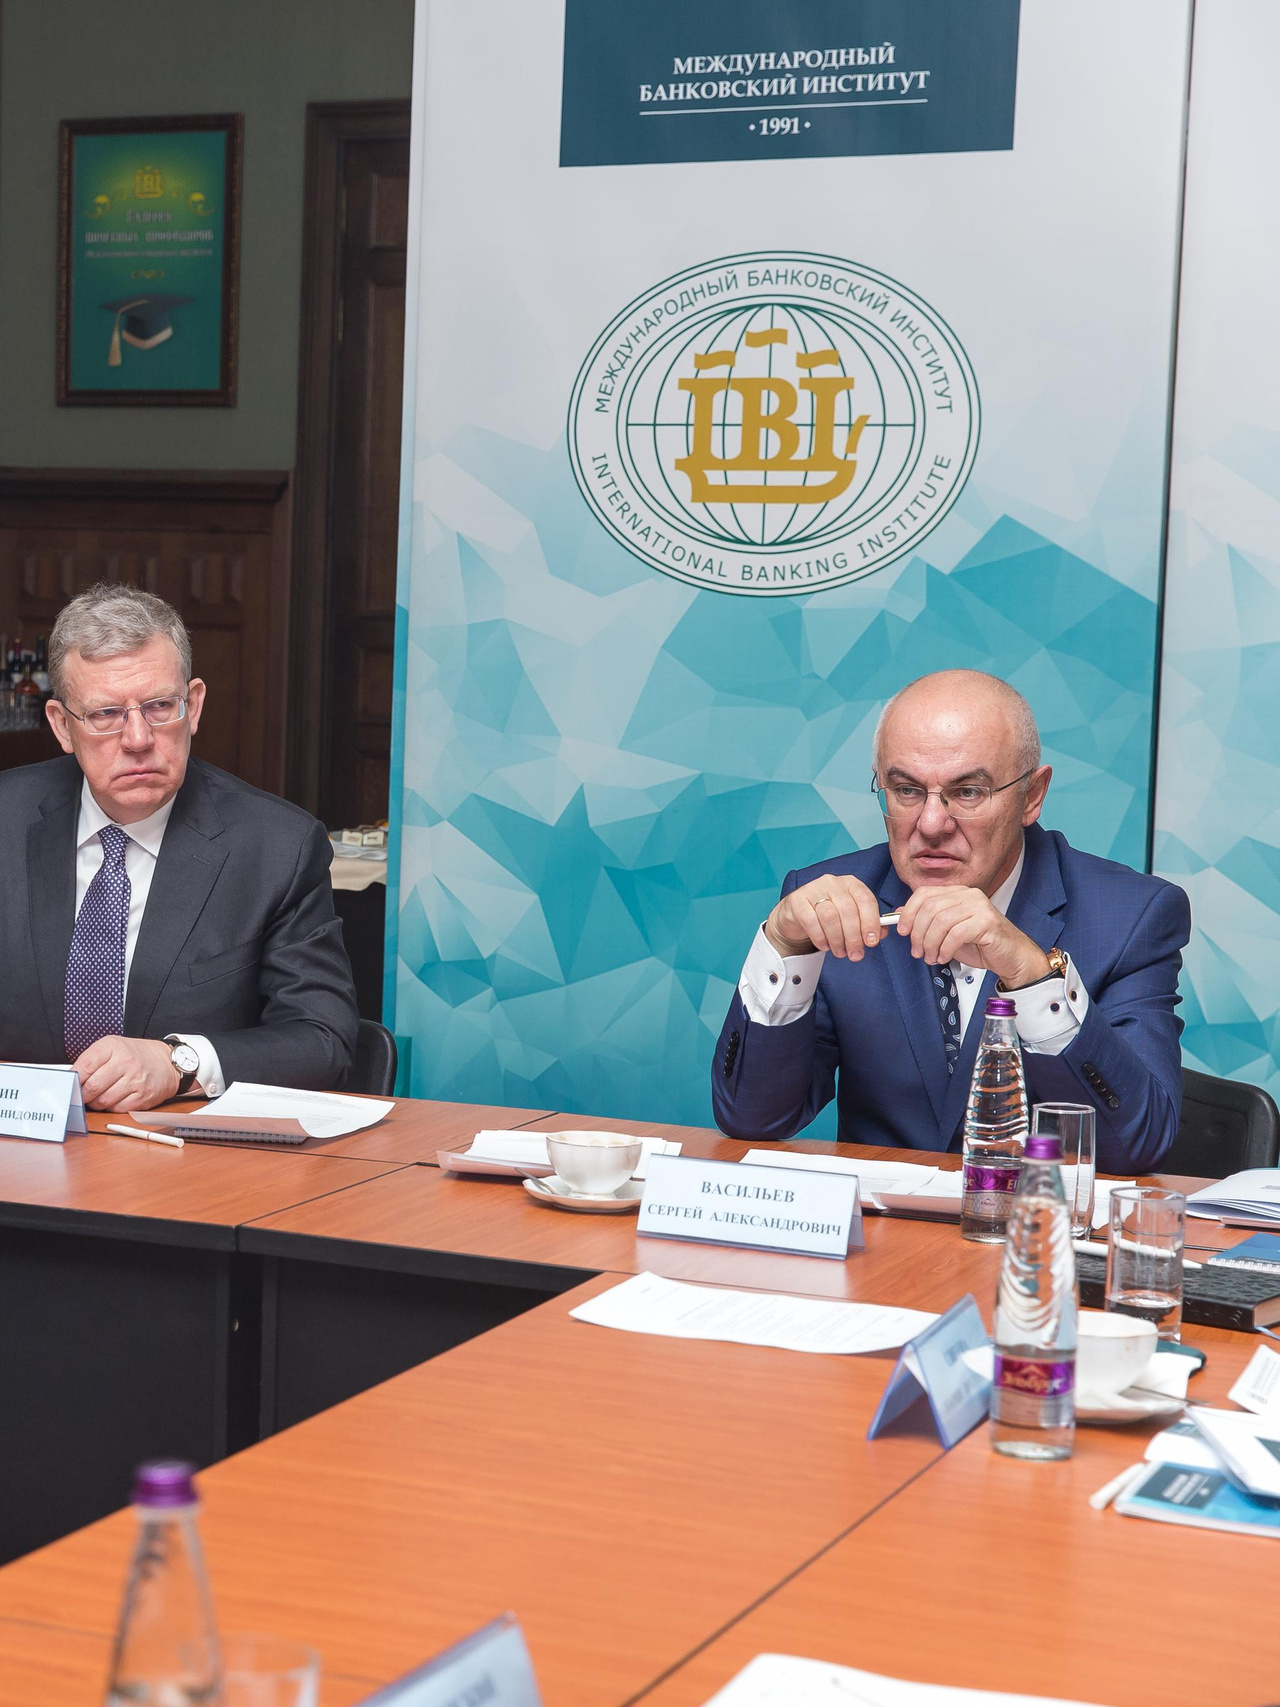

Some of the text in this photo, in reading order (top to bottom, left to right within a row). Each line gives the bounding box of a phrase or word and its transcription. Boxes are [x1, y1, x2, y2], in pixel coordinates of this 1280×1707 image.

[673, 42, 896, 76] МЕЖДУНАРОДНЫЙ
[639, 70, 931, 102] БАНКОВСКИЙ ИНСТИТУТ
[758, 116, 801, 136] 1991
[594, 268, 954, 414] МЕЖДУНАРОДНЫЙ БАНКОВСКИЙ ИНСТИТУТ
[591, 452, 952, 583] INTERNATIONAL BANKING INSTITUTE
[701, 1181, 795, 1203] ВАСИЛЬЕВ
[647, 1203, 842, 1236] СЕРГЕЙ АЛЕКСАНДРОВИЧ
